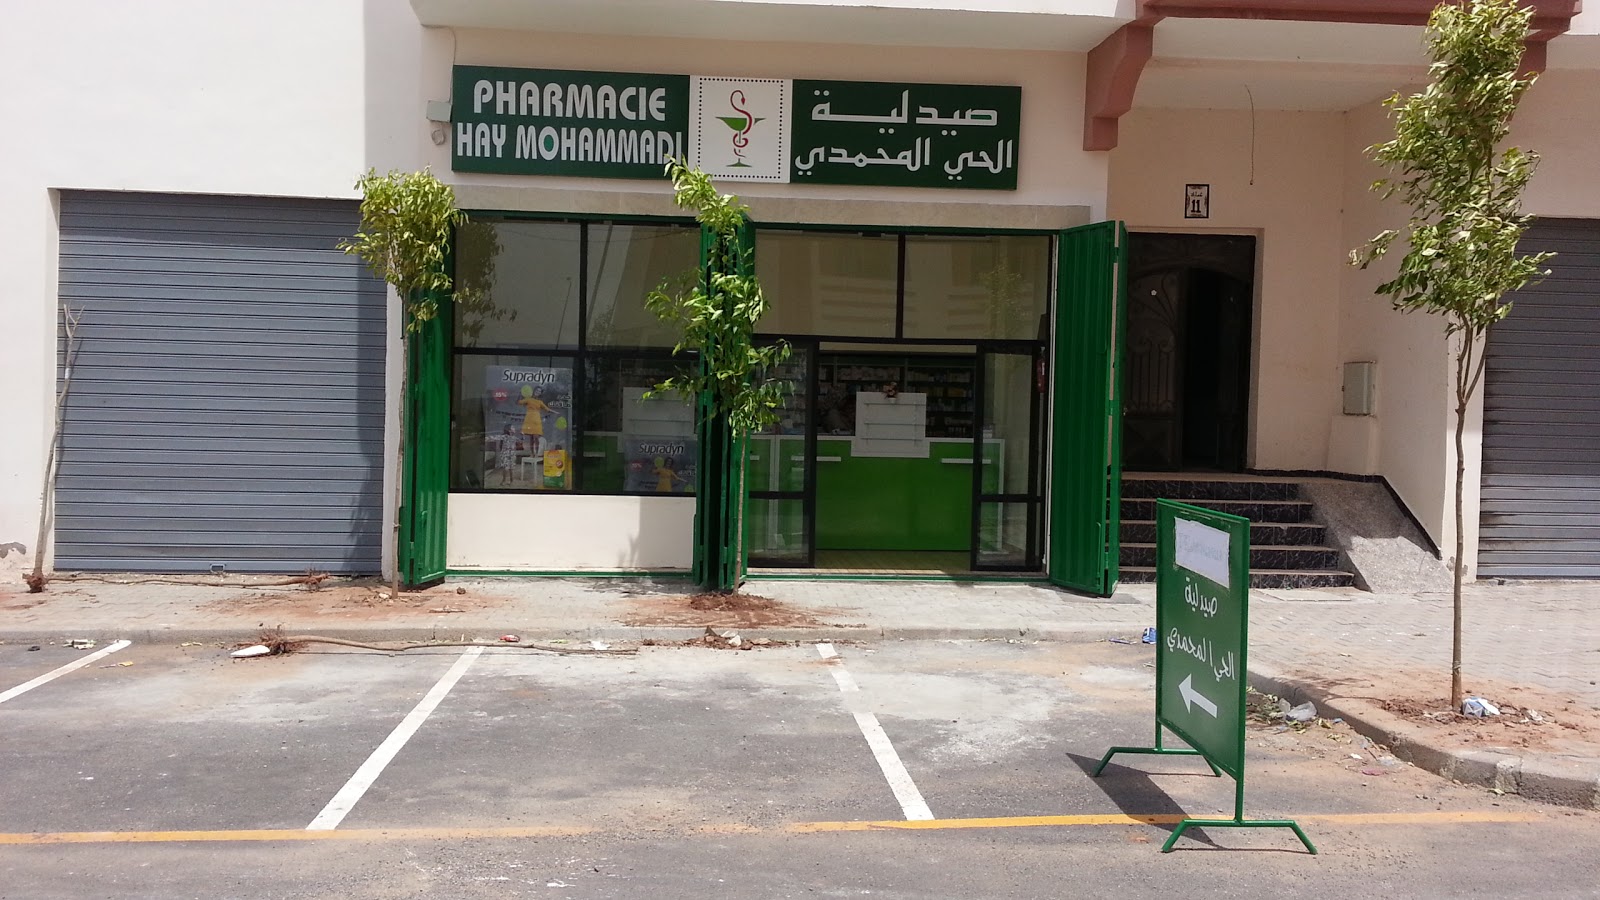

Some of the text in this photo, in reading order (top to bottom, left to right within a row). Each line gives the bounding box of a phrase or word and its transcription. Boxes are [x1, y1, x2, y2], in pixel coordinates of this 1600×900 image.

[473, 79, 666, 122] PHARMACIE
[811, 89, 998, 136] صيدلية
[456, 122, 683, 165] HAY MOHAMMADI
[794, 136, 1013, 181] الحي المحمدي
[1190, 199, 1202, 213] 11
[502, 369, 555, 385] Supradyn
[639, 442, 684, 456] Supradyn
[1184, 576, 1218, 618] صيدلية
[1167, 627, 1236, 682] الحي المحمدي
